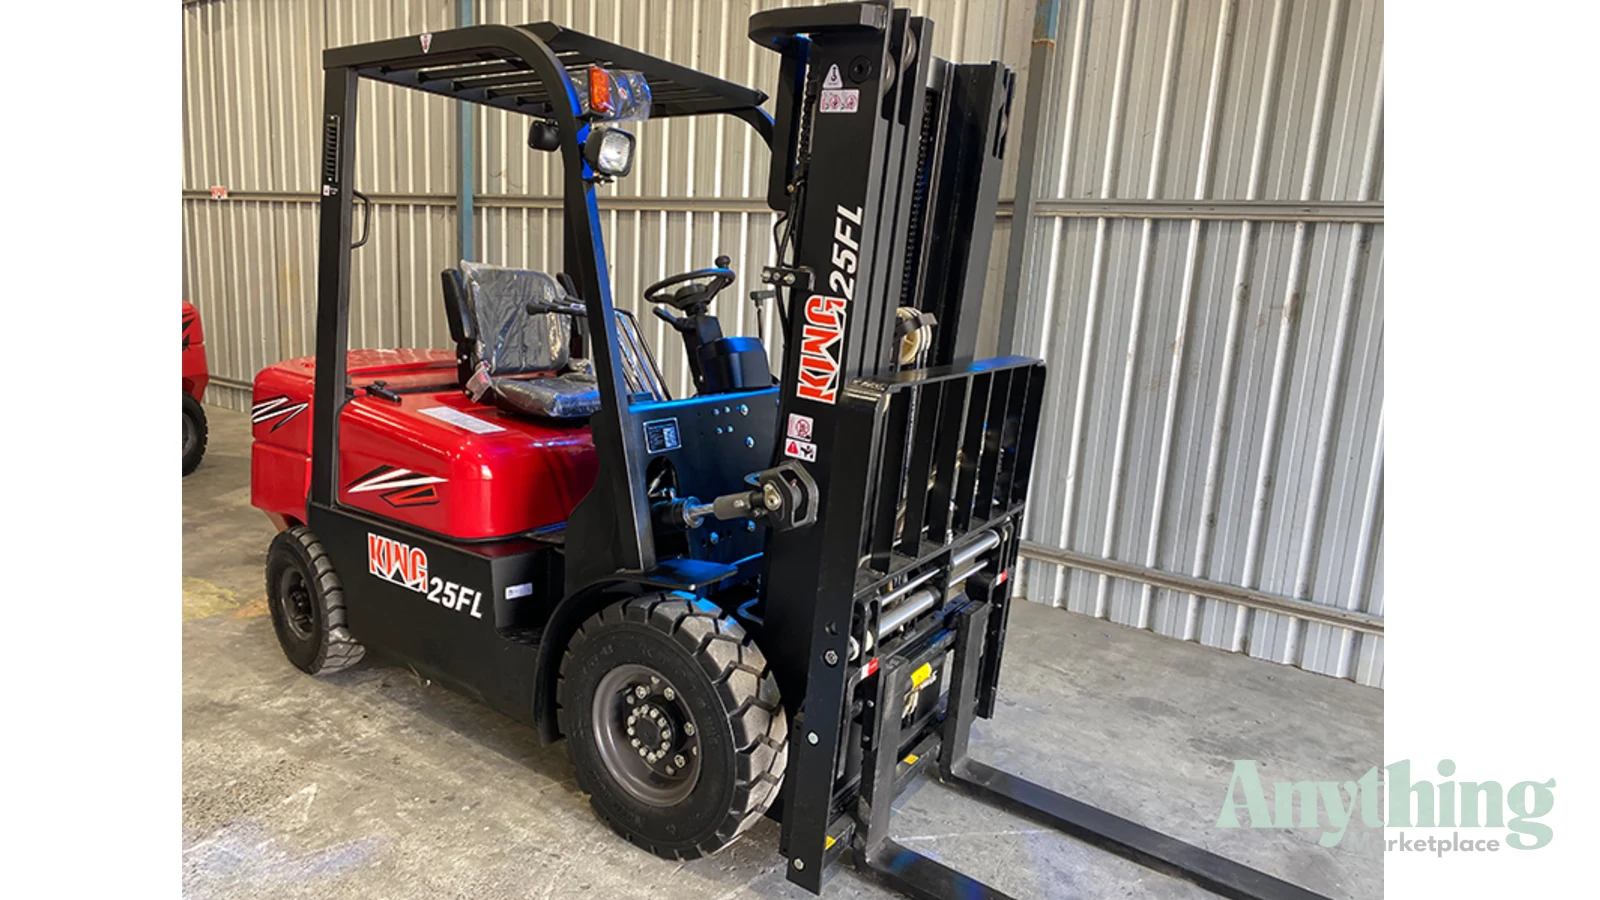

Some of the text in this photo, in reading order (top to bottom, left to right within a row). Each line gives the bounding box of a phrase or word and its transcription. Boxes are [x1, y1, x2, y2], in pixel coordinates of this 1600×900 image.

[796, 294, 848, 404] KING
[828, 204, 864, 301] 25FL
[367, 532, 482, 619] KING 25FL
